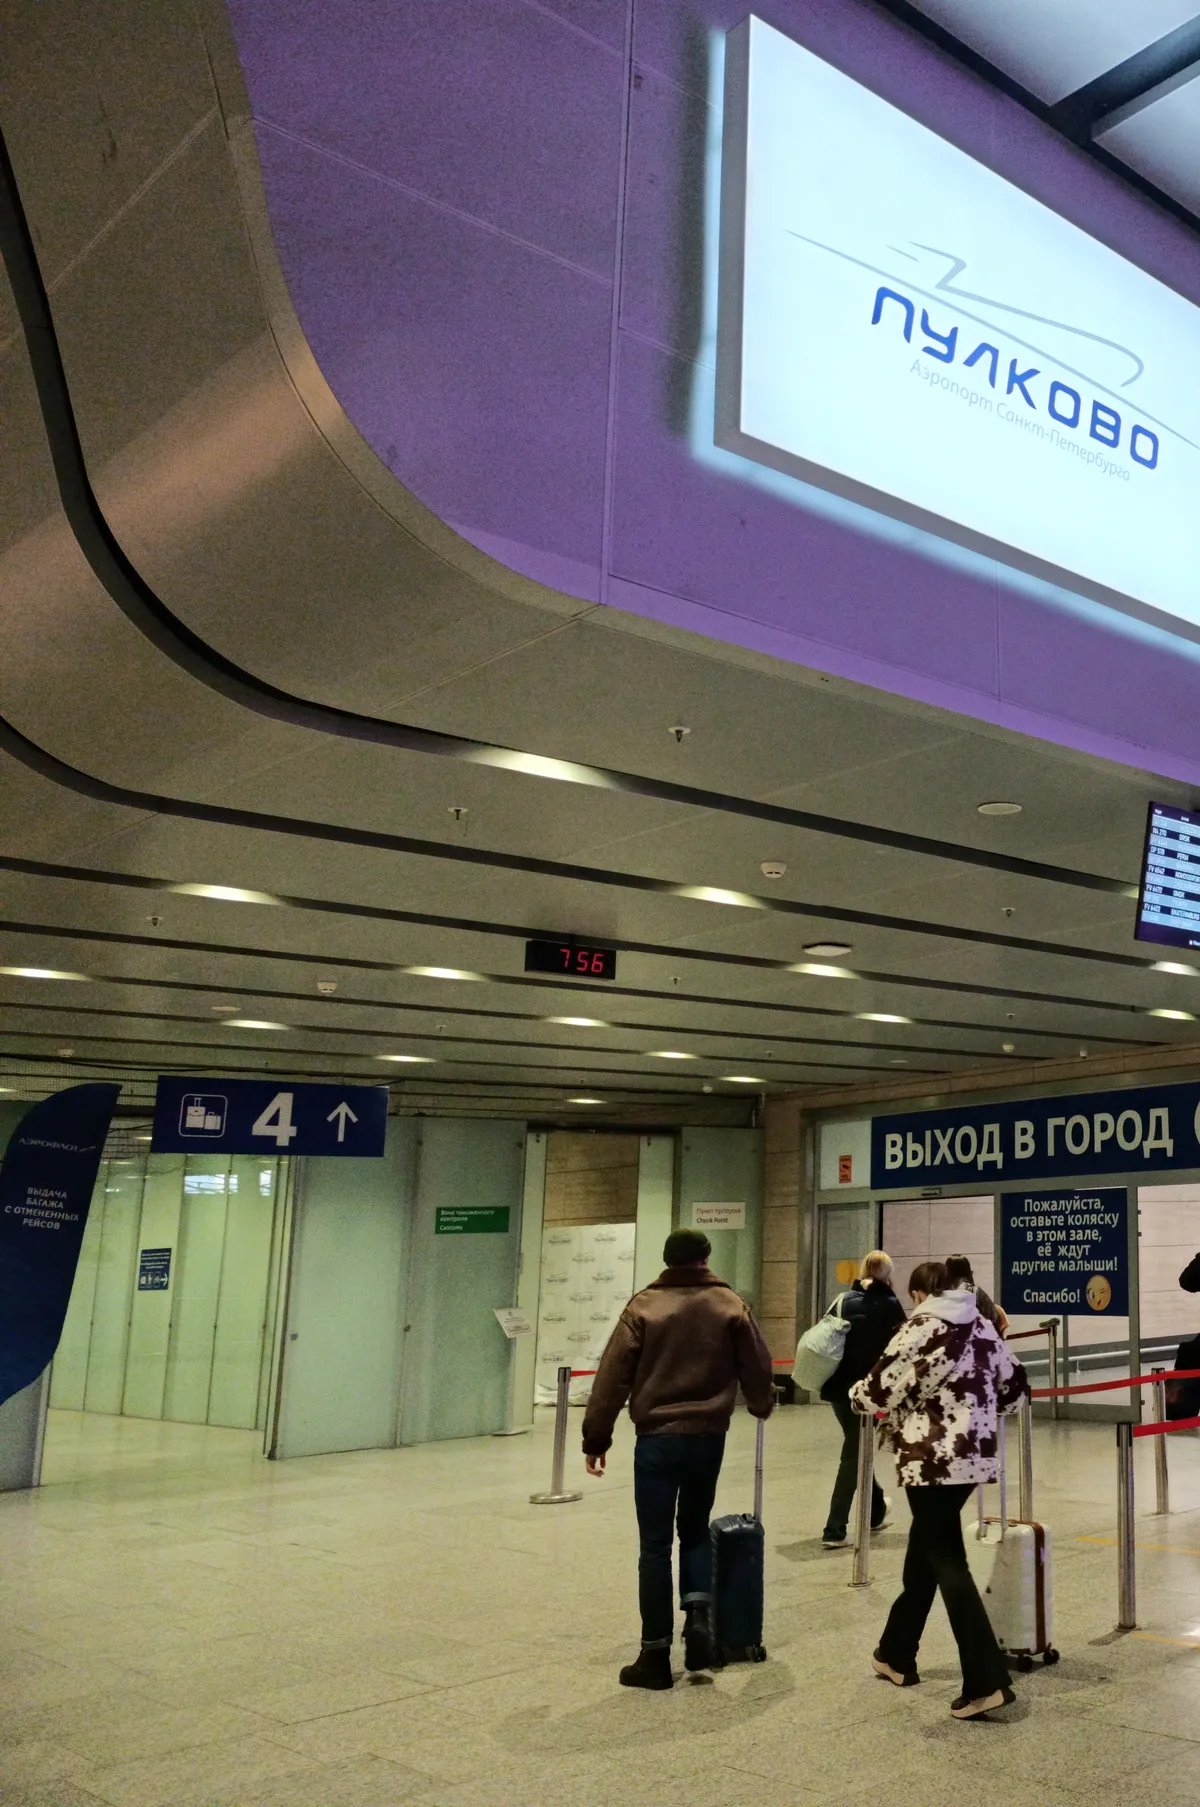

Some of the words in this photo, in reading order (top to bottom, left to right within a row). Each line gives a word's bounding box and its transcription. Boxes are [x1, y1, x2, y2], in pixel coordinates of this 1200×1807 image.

[871, 286, 1159, 470] ПУЛКОВО
[910, 358, 994, 413] Аэропорт
[996, 402, 1131, 482] Санкт-Петербурга
[251, 1092, 298, 1147] 4
[884, 1122, 1004, 1171] ВЫХОД
[1014, 1120, 1036, 1160] В
[1047, 1107, 1174, 1159] ГОРОД
[27, 1187, 68, 1199] ВЫДАЧА
[26, 1197, 64, 1209] БАГАЖА
[1024, 1195, 1105, 1214] Пожалуйста,
[22, 1218, 61, 1230] РЕЙСОВ
[1010, 1215, 1065, 1228] оставьте
[1067, 1213, 1120, 1228] коляску
[1026, 1231, 1034, 1242] в
[1036, 1230, 1067, 1242] этом
[1069, 1228, 1102, 1243] зале,
[1037, 1242, 1052, 1257] её
[1057, 1244, 1091, 1259] ждут
[1011, 1260, 1056, 1275] другие
[1058, 1256, 1118, 1272] малыши!
[1023, 1288, 1081, 1303] Спасибо!
